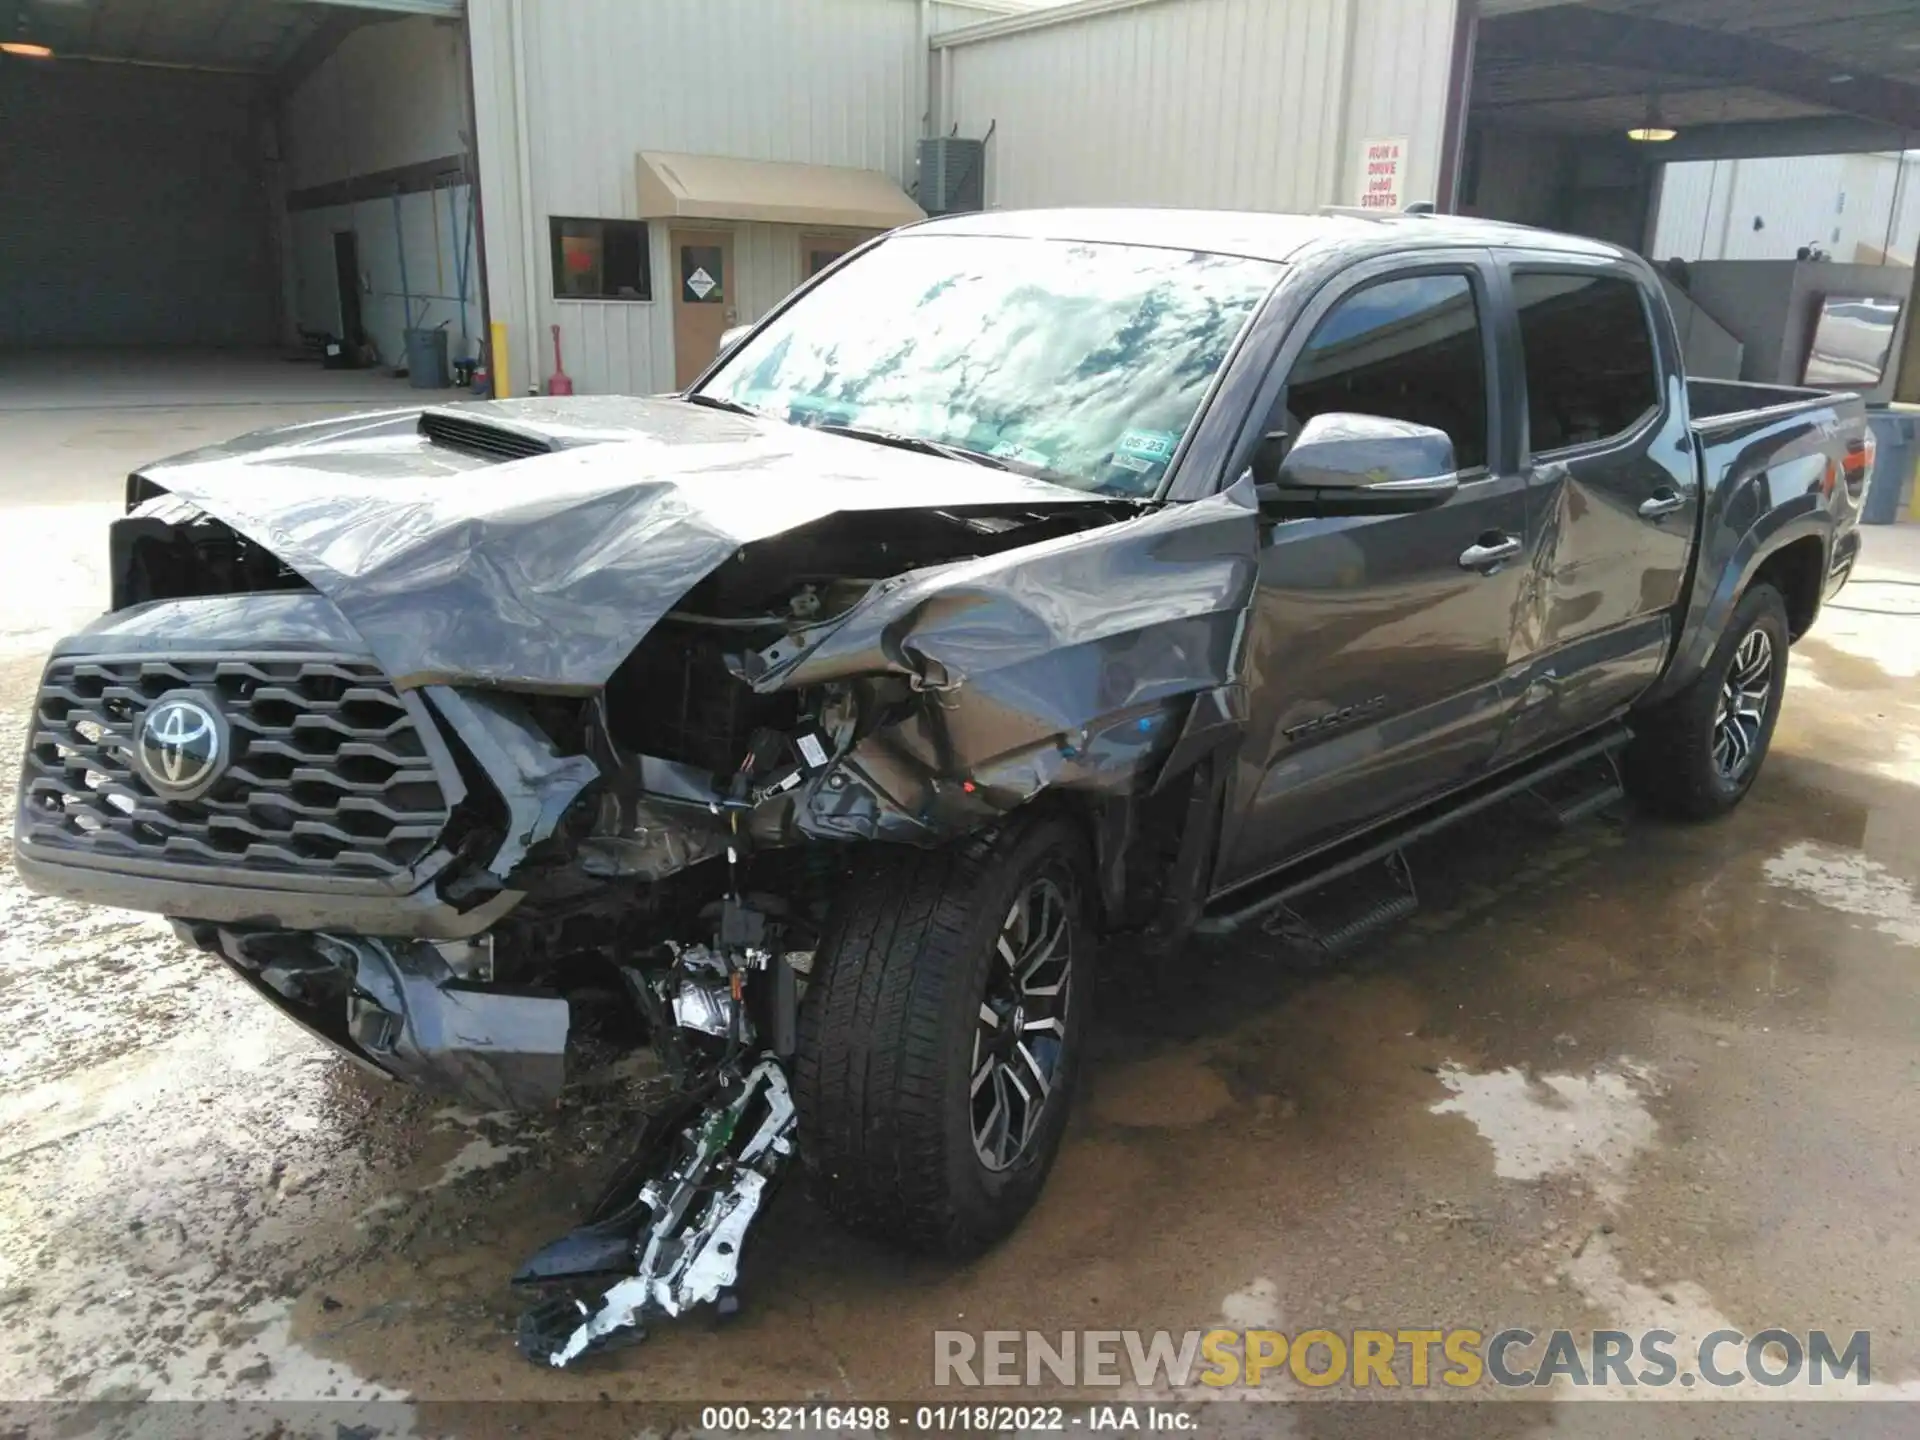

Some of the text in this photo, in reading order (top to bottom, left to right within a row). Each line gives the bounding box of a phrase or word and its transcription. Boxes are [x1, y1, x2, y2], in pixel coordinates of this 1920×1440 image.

[1369, 145, 1390, 159] RUN
[1368, 162, 1396, 175] DRIVE
[1361, 194, 1397, 208] STARTS
